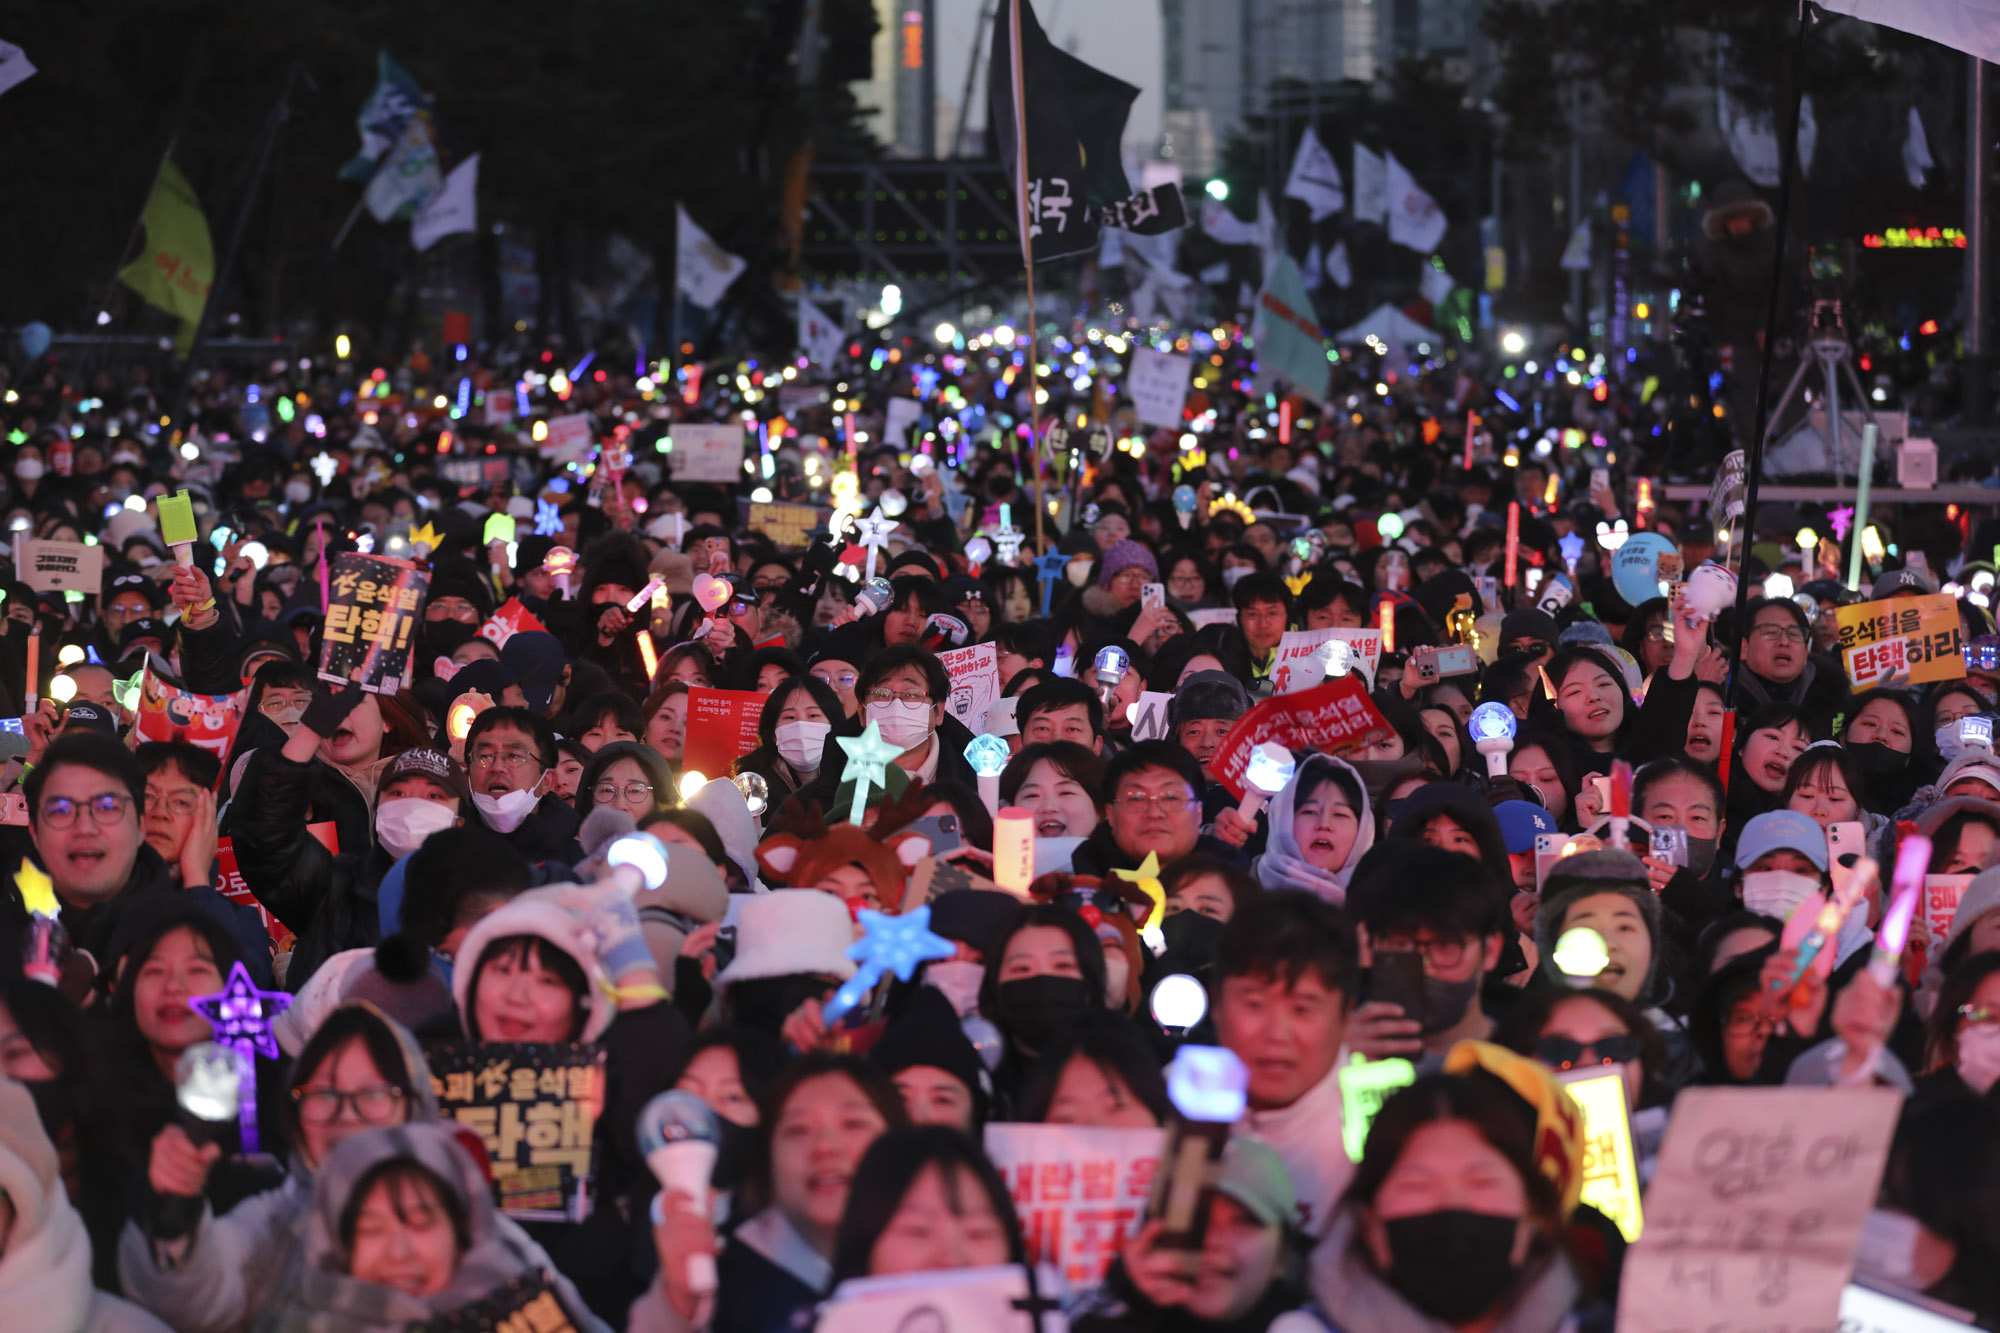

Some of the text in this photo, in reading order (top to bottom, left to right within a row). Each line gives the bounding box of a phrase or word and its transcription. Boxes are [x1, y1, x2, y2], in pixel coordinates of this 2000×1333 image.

[356, 580, 420, 611] 윤석열
[323, 603, 414, 650] 탄핵!
[1839, 609, 1921, 650] 윤석열을
[1853, 628, 1962, 682] 탄핵하라
[1295, 694, 1364, 727] 윤석열
[1533, 815, 1546, 830] LA
[508, 1065, 606, 1101] 윤석열
[456, 1099, 595, 1180] 탄핵
